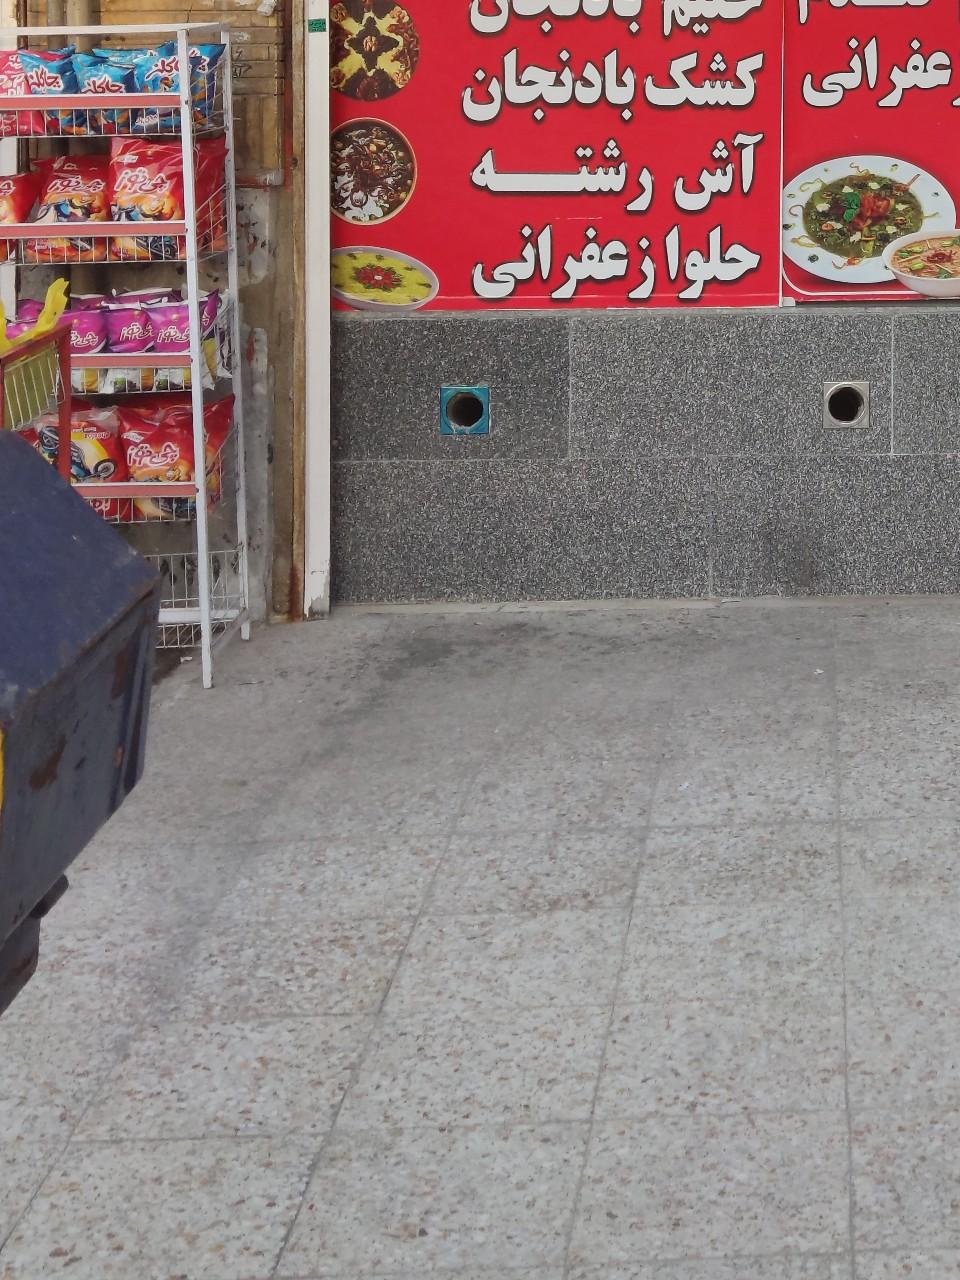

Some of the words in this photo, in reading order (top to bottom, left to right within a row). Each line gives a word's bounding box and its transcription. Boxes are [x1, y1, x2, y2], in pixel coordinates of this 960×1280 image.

[461, 44, 637, 121] بادنجان
[643, 51, 765, 110] کشک
[470, 137, 653, 211] رشته
[673, 132, 766, 211] آش
[472, 226, 657, 304] زعفرانی
[666, 225, 762, 301] حلوا
